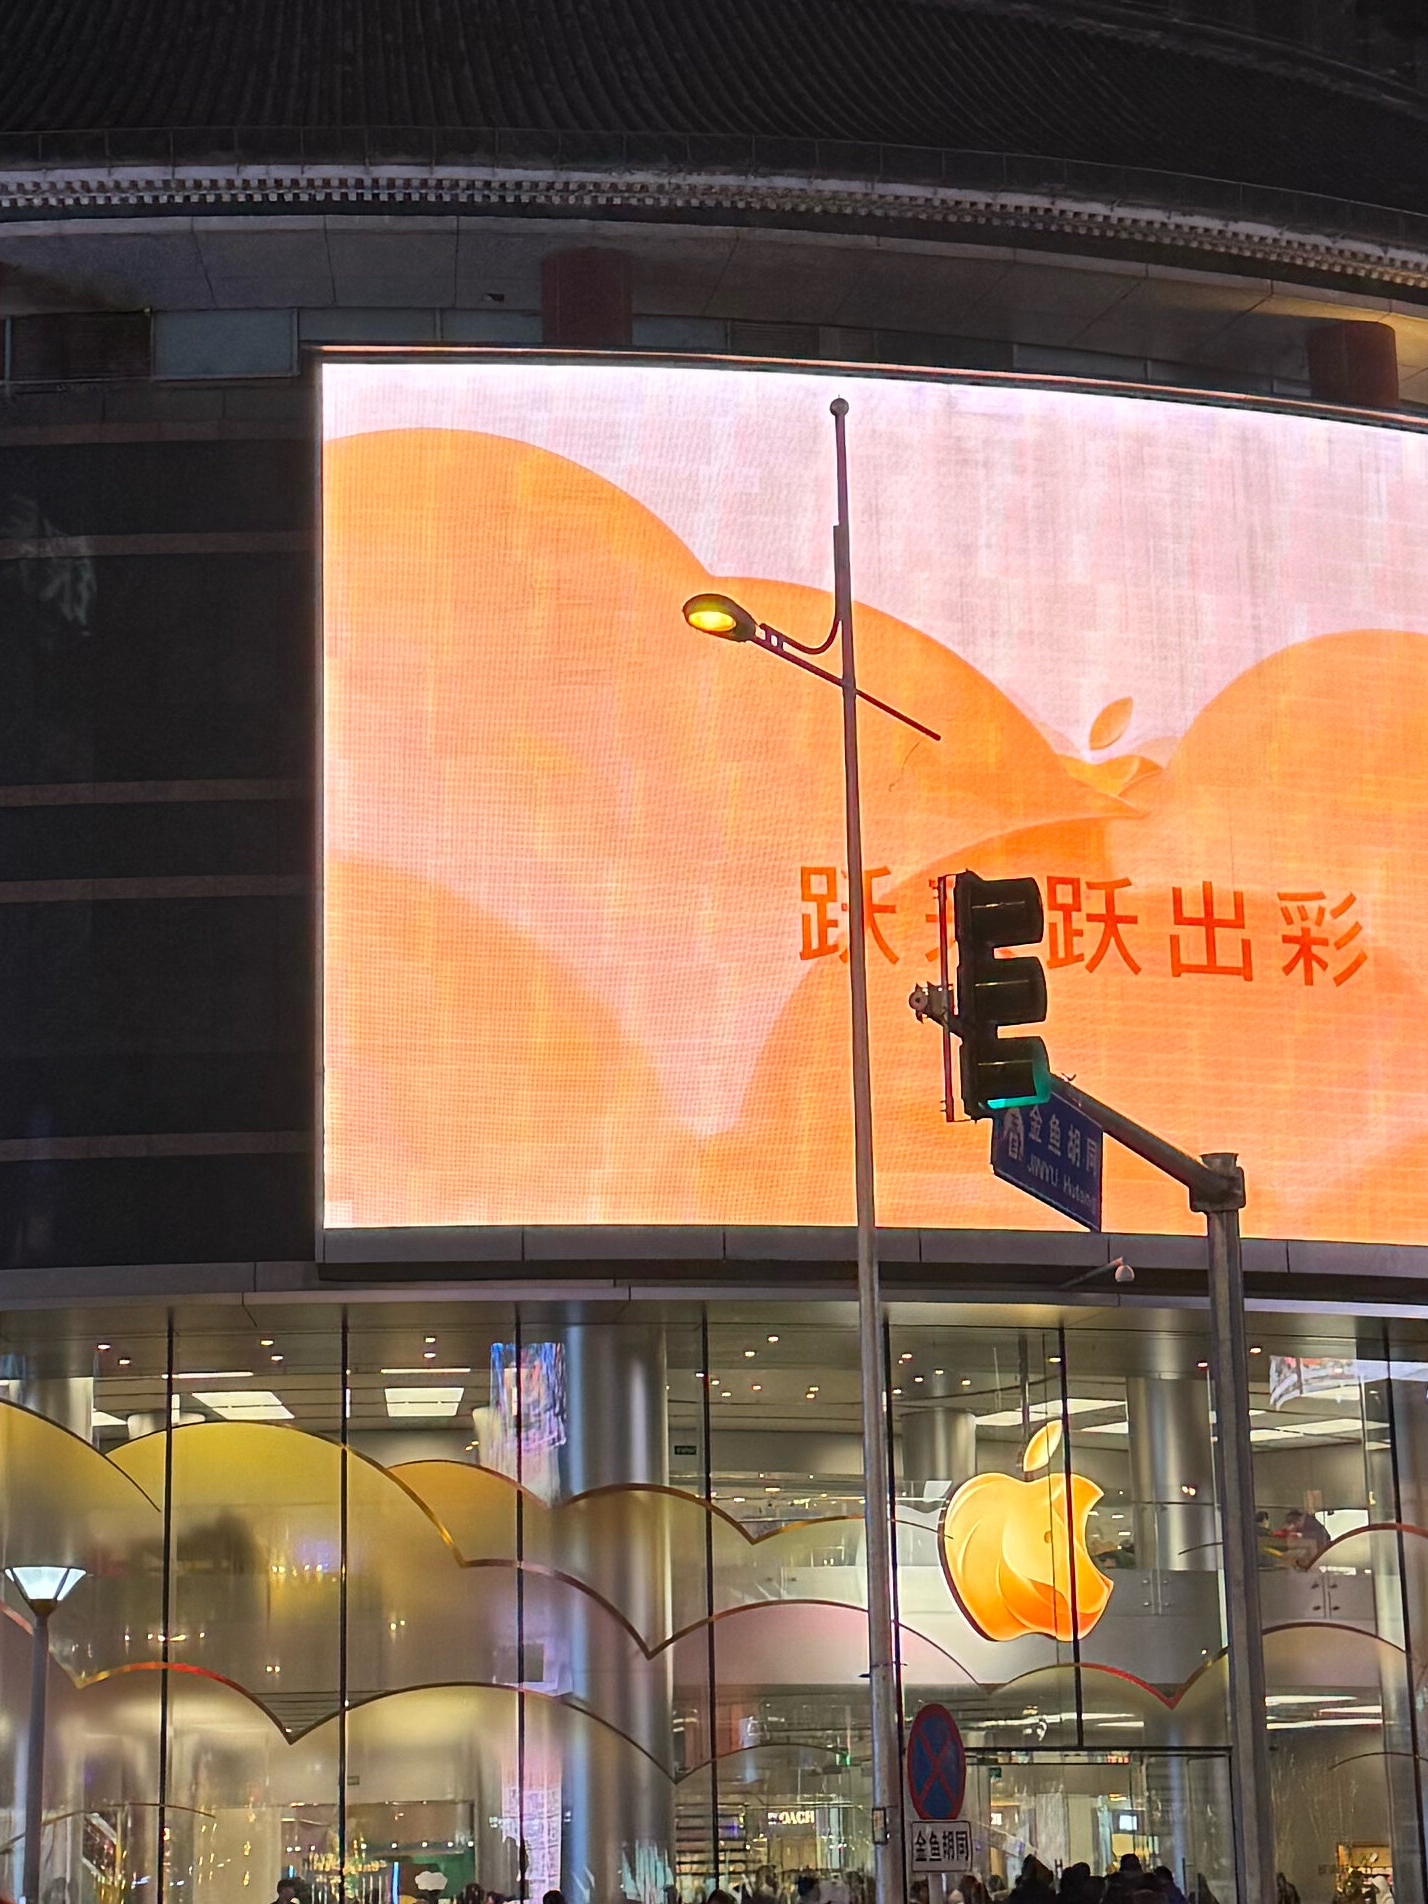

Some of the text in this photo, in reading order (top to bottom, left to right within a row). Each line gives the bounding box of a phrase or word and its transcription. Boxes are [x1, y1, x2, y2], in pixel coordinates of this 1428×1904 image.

[799, 865, 1368, 987] 跃跃出彩
[1028, 1104, 1098, 1177] 金鱼胡同
[915, 1829, 969, 1863] 金鱼胡同
